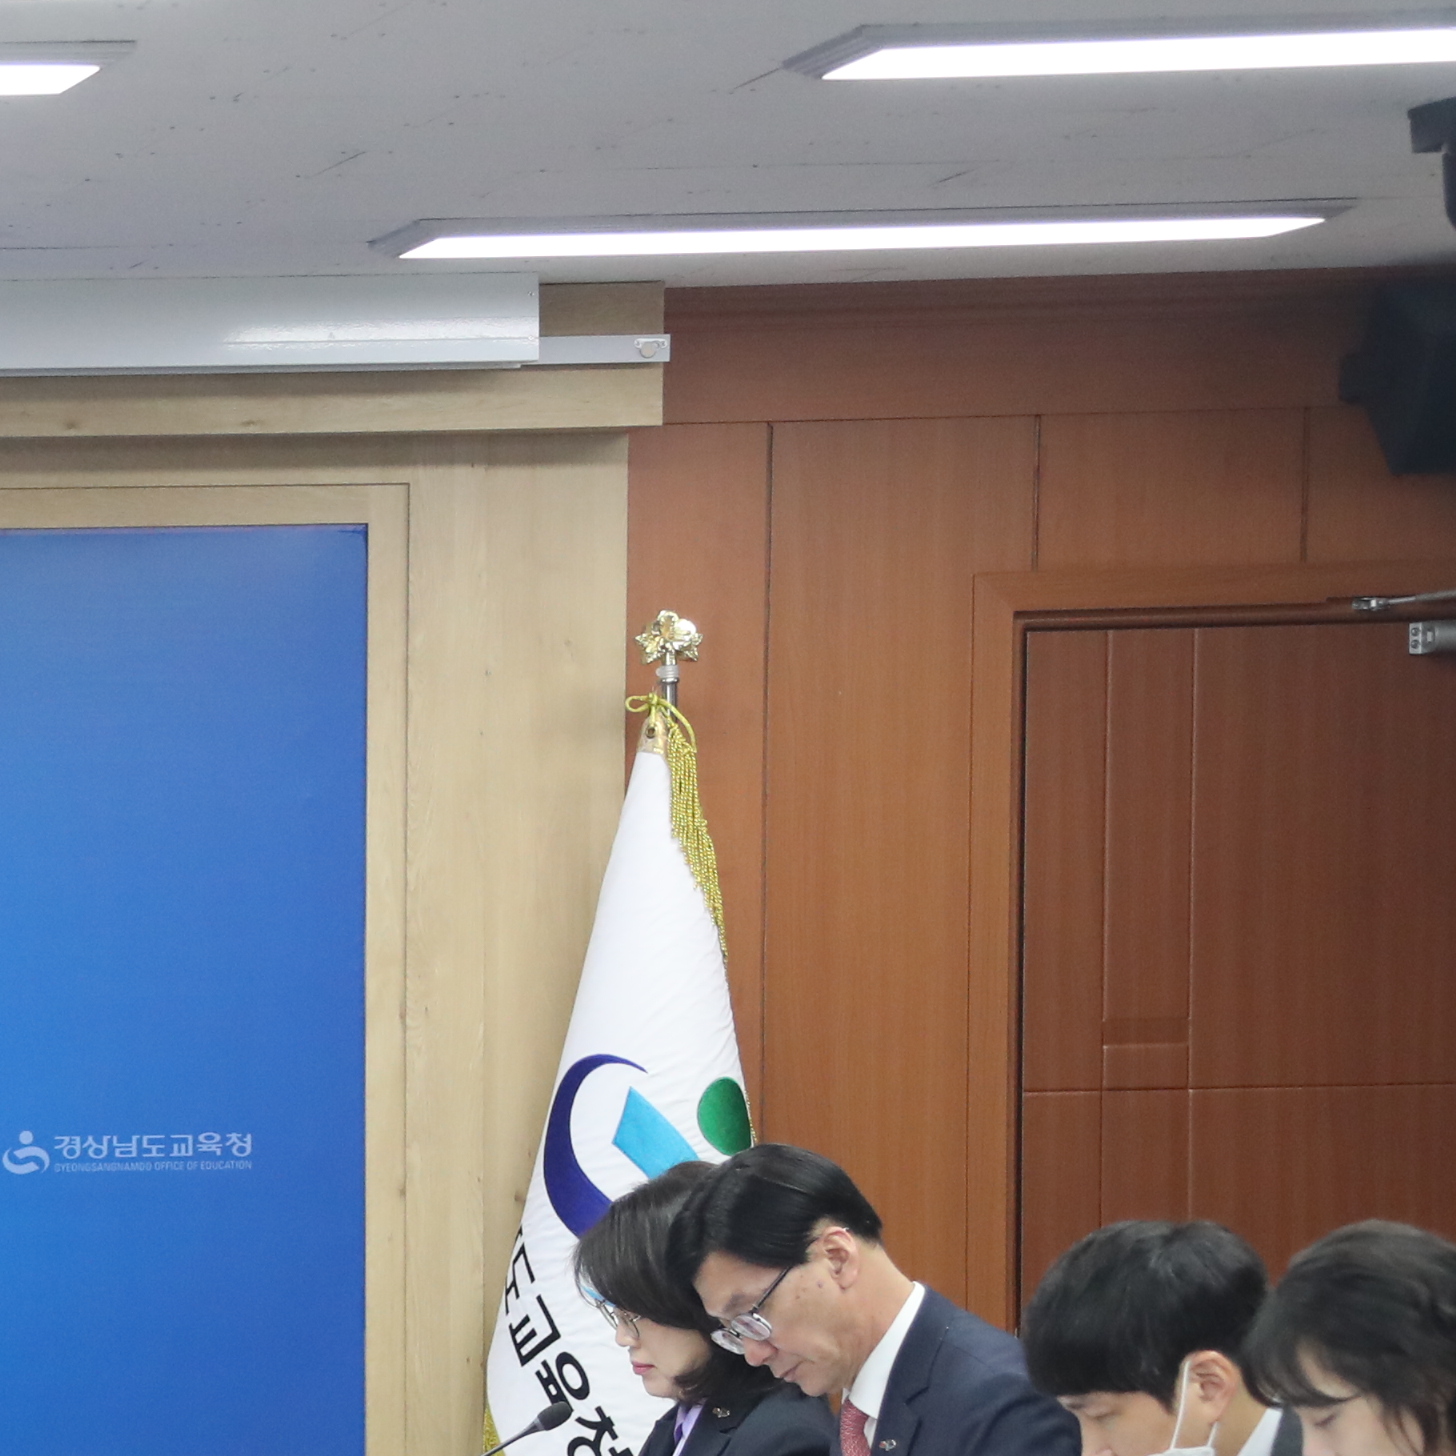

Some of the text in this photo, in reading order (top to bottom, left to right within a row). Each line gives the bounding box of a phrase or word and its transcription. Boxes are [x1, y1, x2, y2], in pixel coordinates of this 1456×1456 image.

[54, 1132, 252, 1160] 경상남도교육청
[154, 1160, 184, 1171] OFFICE
[187, 1160, 198, 1171] OF
[200, 1159, 252, 1170] EDUCATION
